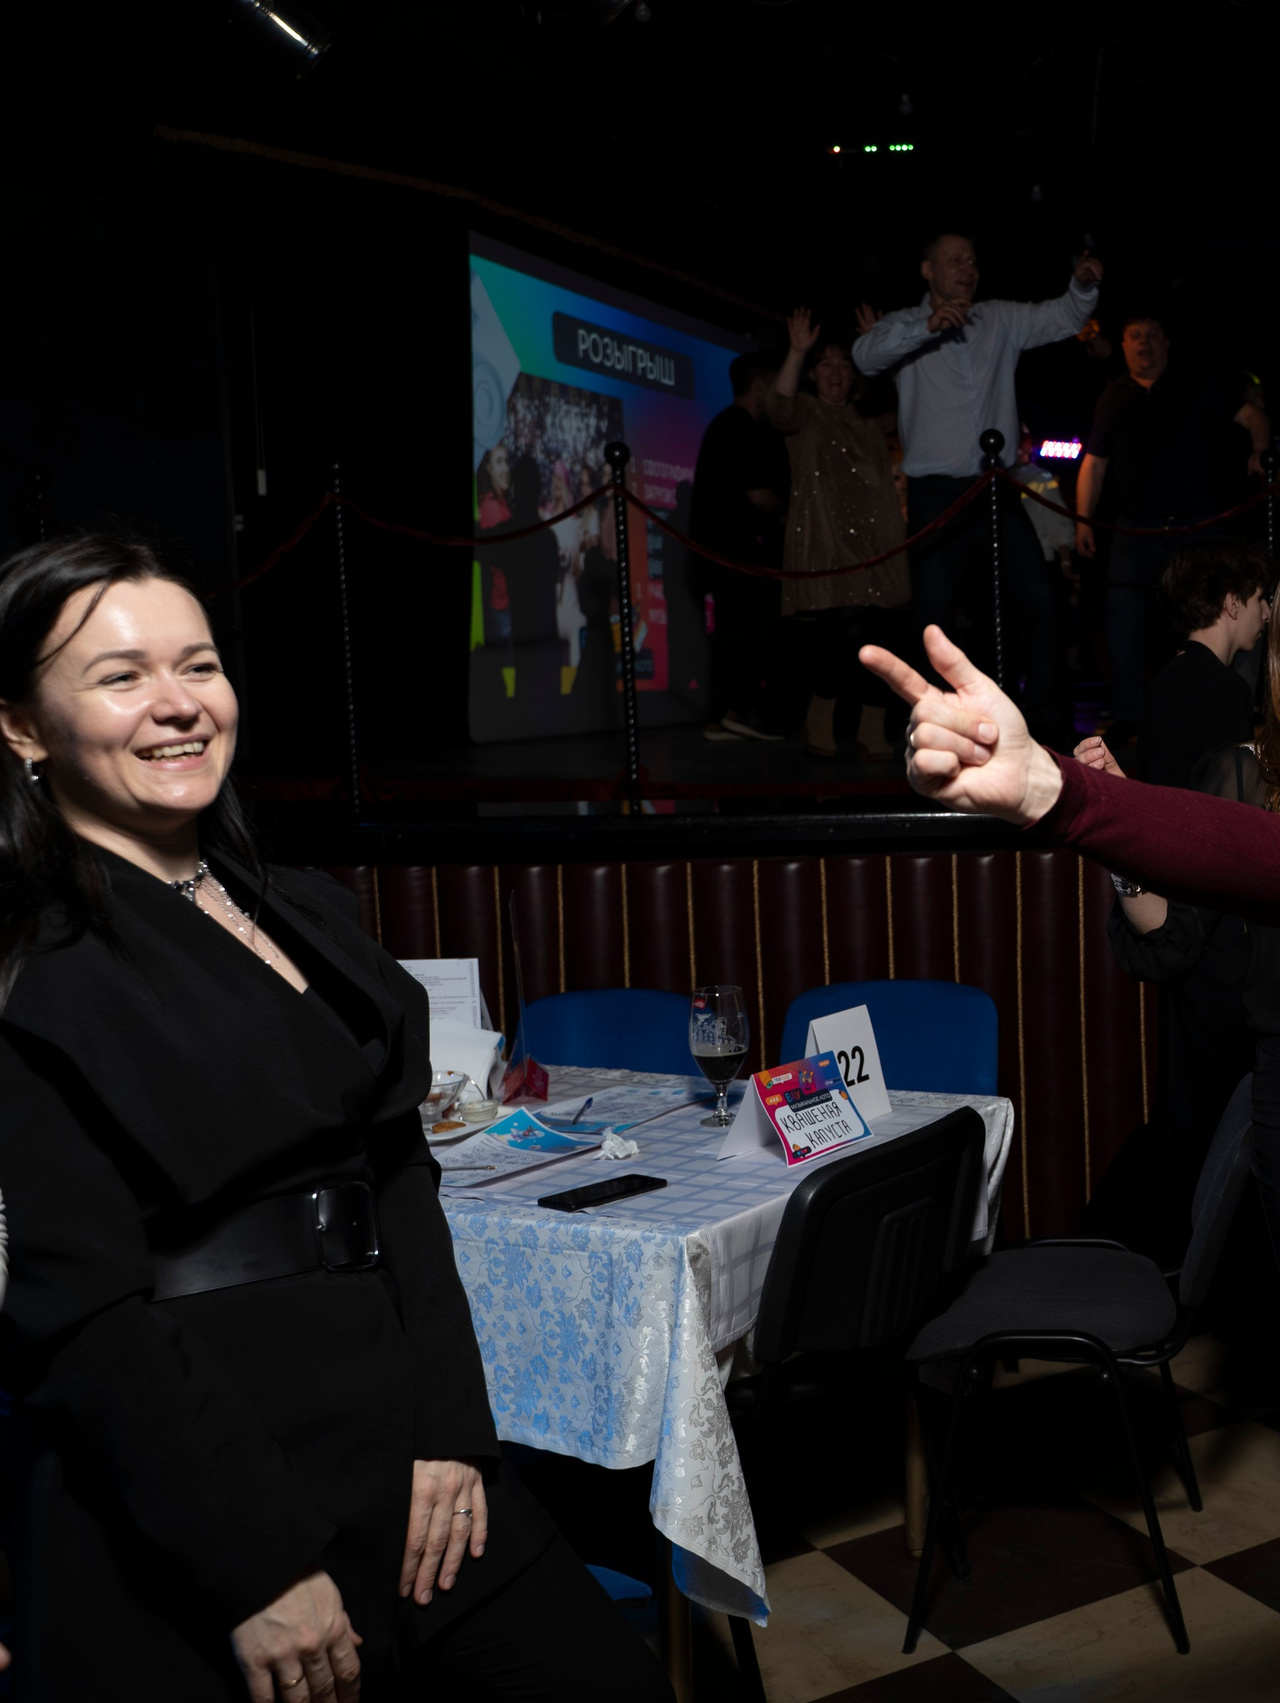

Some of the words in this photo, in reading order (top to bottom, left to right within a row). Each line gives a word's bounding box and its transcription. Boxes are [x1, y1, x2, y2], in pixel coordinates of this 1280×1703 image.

[577, 327, 675, 388] РОЗЫГРЫШ
[837, 1045, 870, 1088] 22
[785, 1089, 801, 1103] ВАУ
[779, 1101, 843, 1134] КВАШЕНАЯ
[804, 1119, 852, 1149] КАПУСТА
